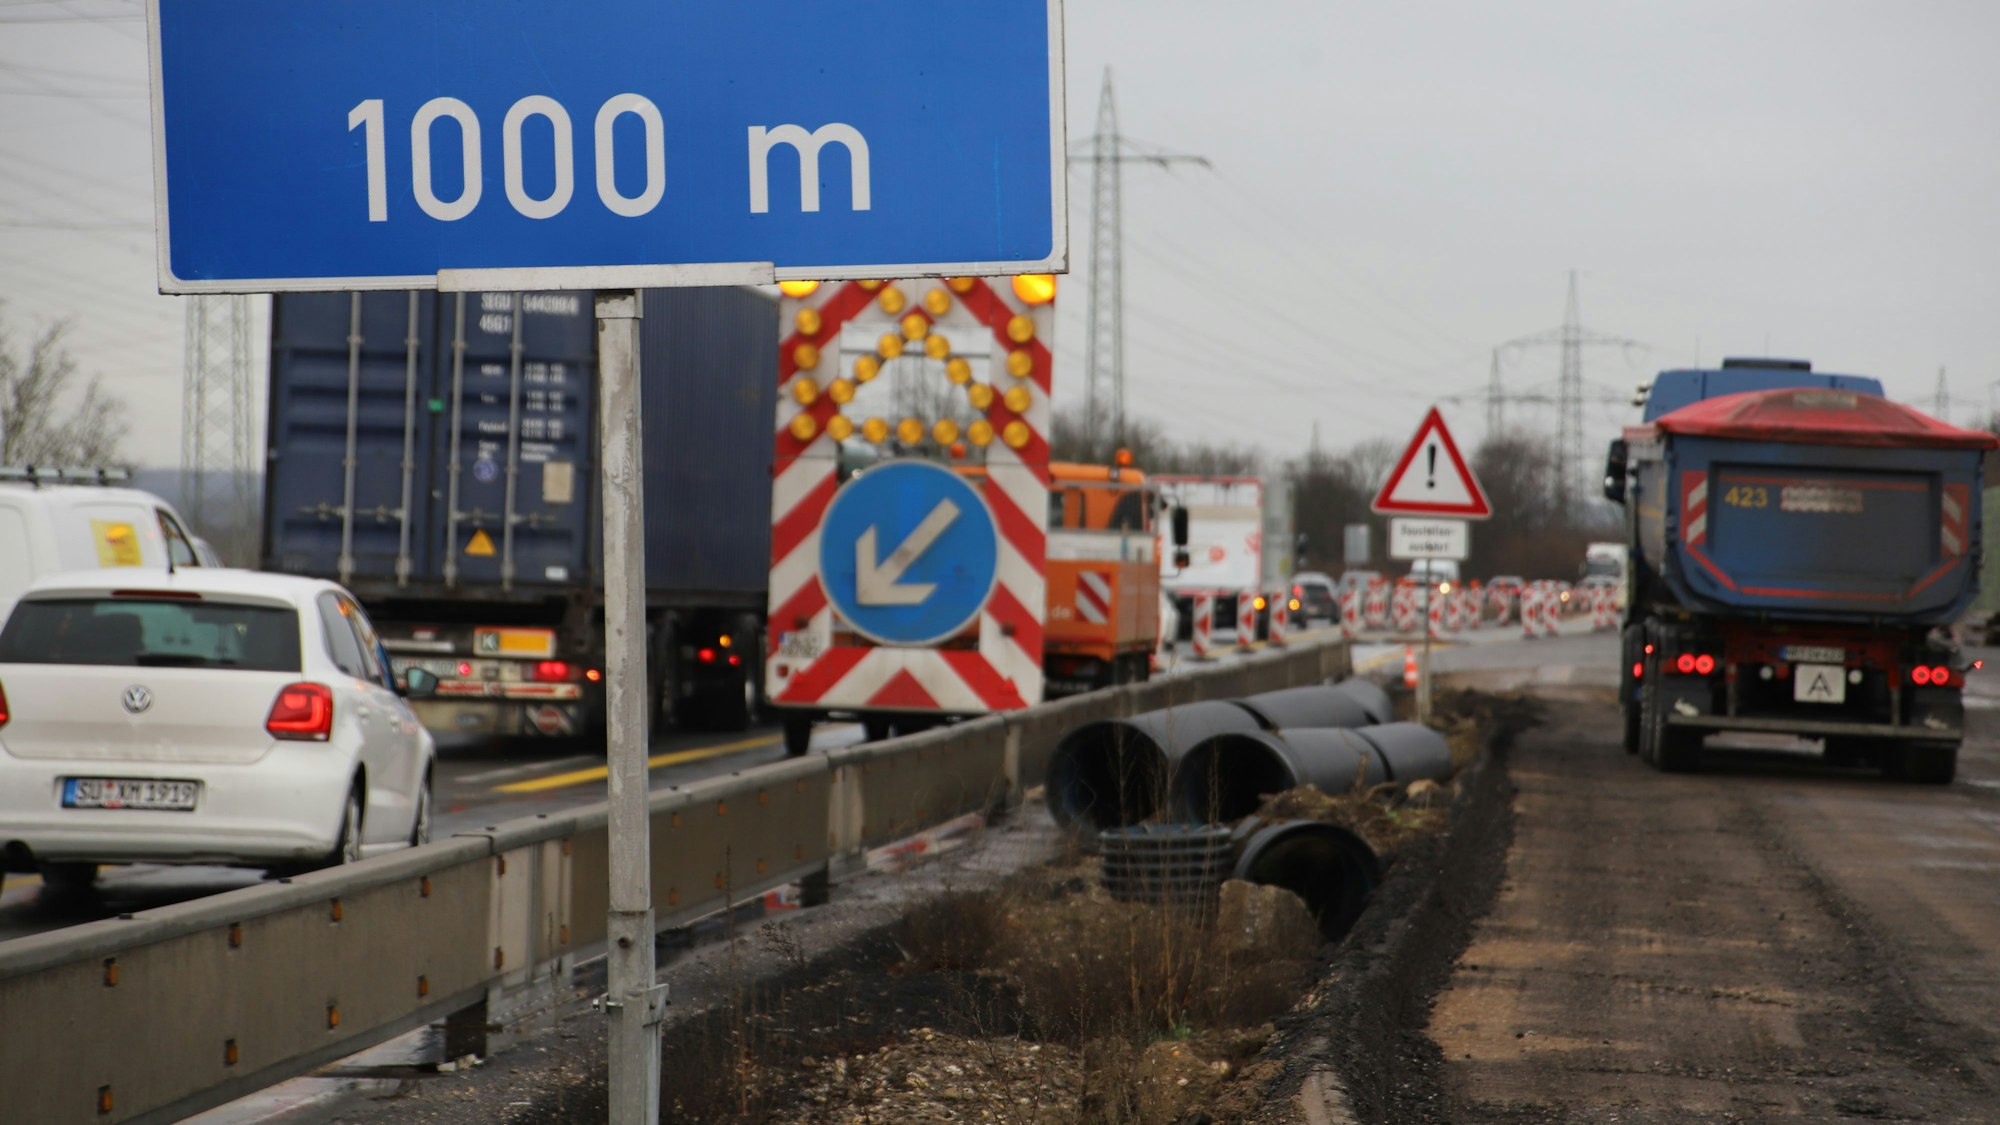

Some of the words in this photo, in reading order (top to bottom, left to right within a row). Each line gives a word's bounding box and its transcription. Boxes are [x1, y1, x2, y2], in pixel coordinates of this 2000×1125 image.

[348, 92, 666, 222] 1000
[748, 122, 872, 213] m
[481, 293, 511, 311] SEGU
[1724, 487, 1768, 508] 423
[1807, 673, 1832, 696] A
[145, 783, 195, 802] 1919
